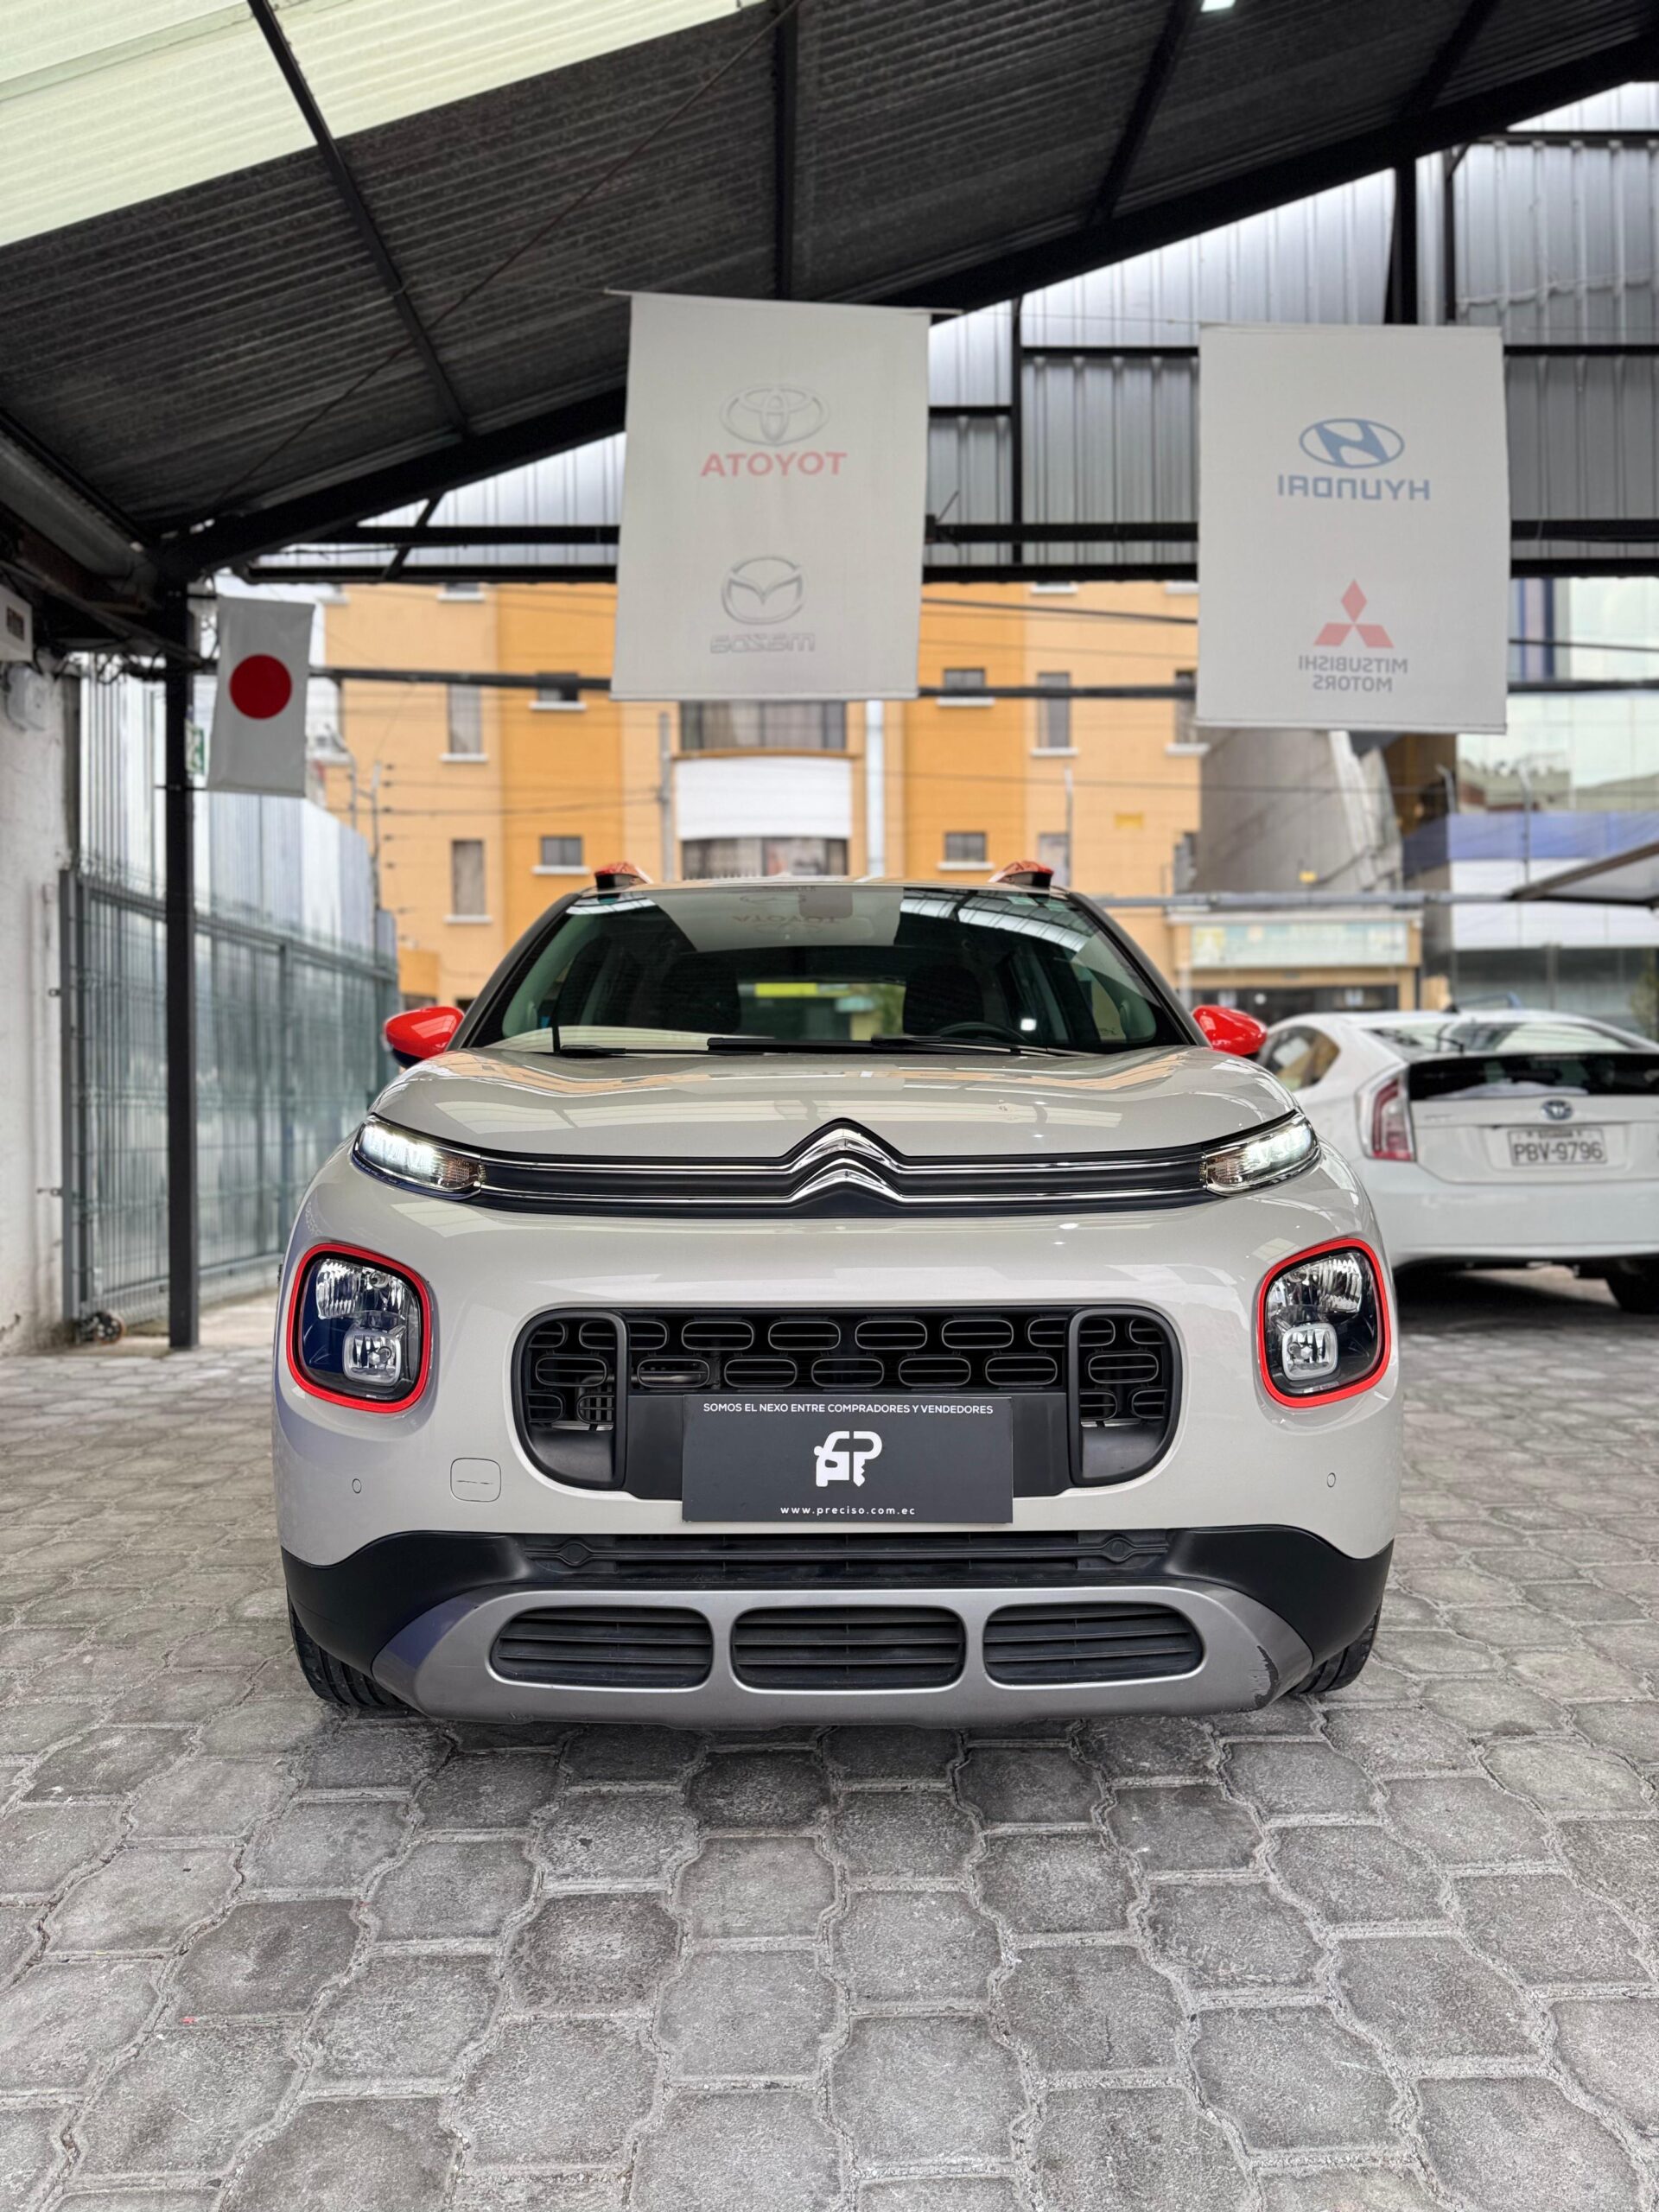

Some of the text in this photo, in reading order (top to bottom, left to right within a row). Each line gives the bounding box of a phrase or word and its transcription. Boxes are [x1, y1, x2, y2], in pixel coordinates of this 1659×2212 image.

[1514, 1141, 1603, 1162] PBV-9796
[702, 1402, 994, 1414] SOMOS EL NEXO ENTRE COMPRADORES Y VENDEDORES
[780, 1505, 915, 1516] www.preciso.com.ec
